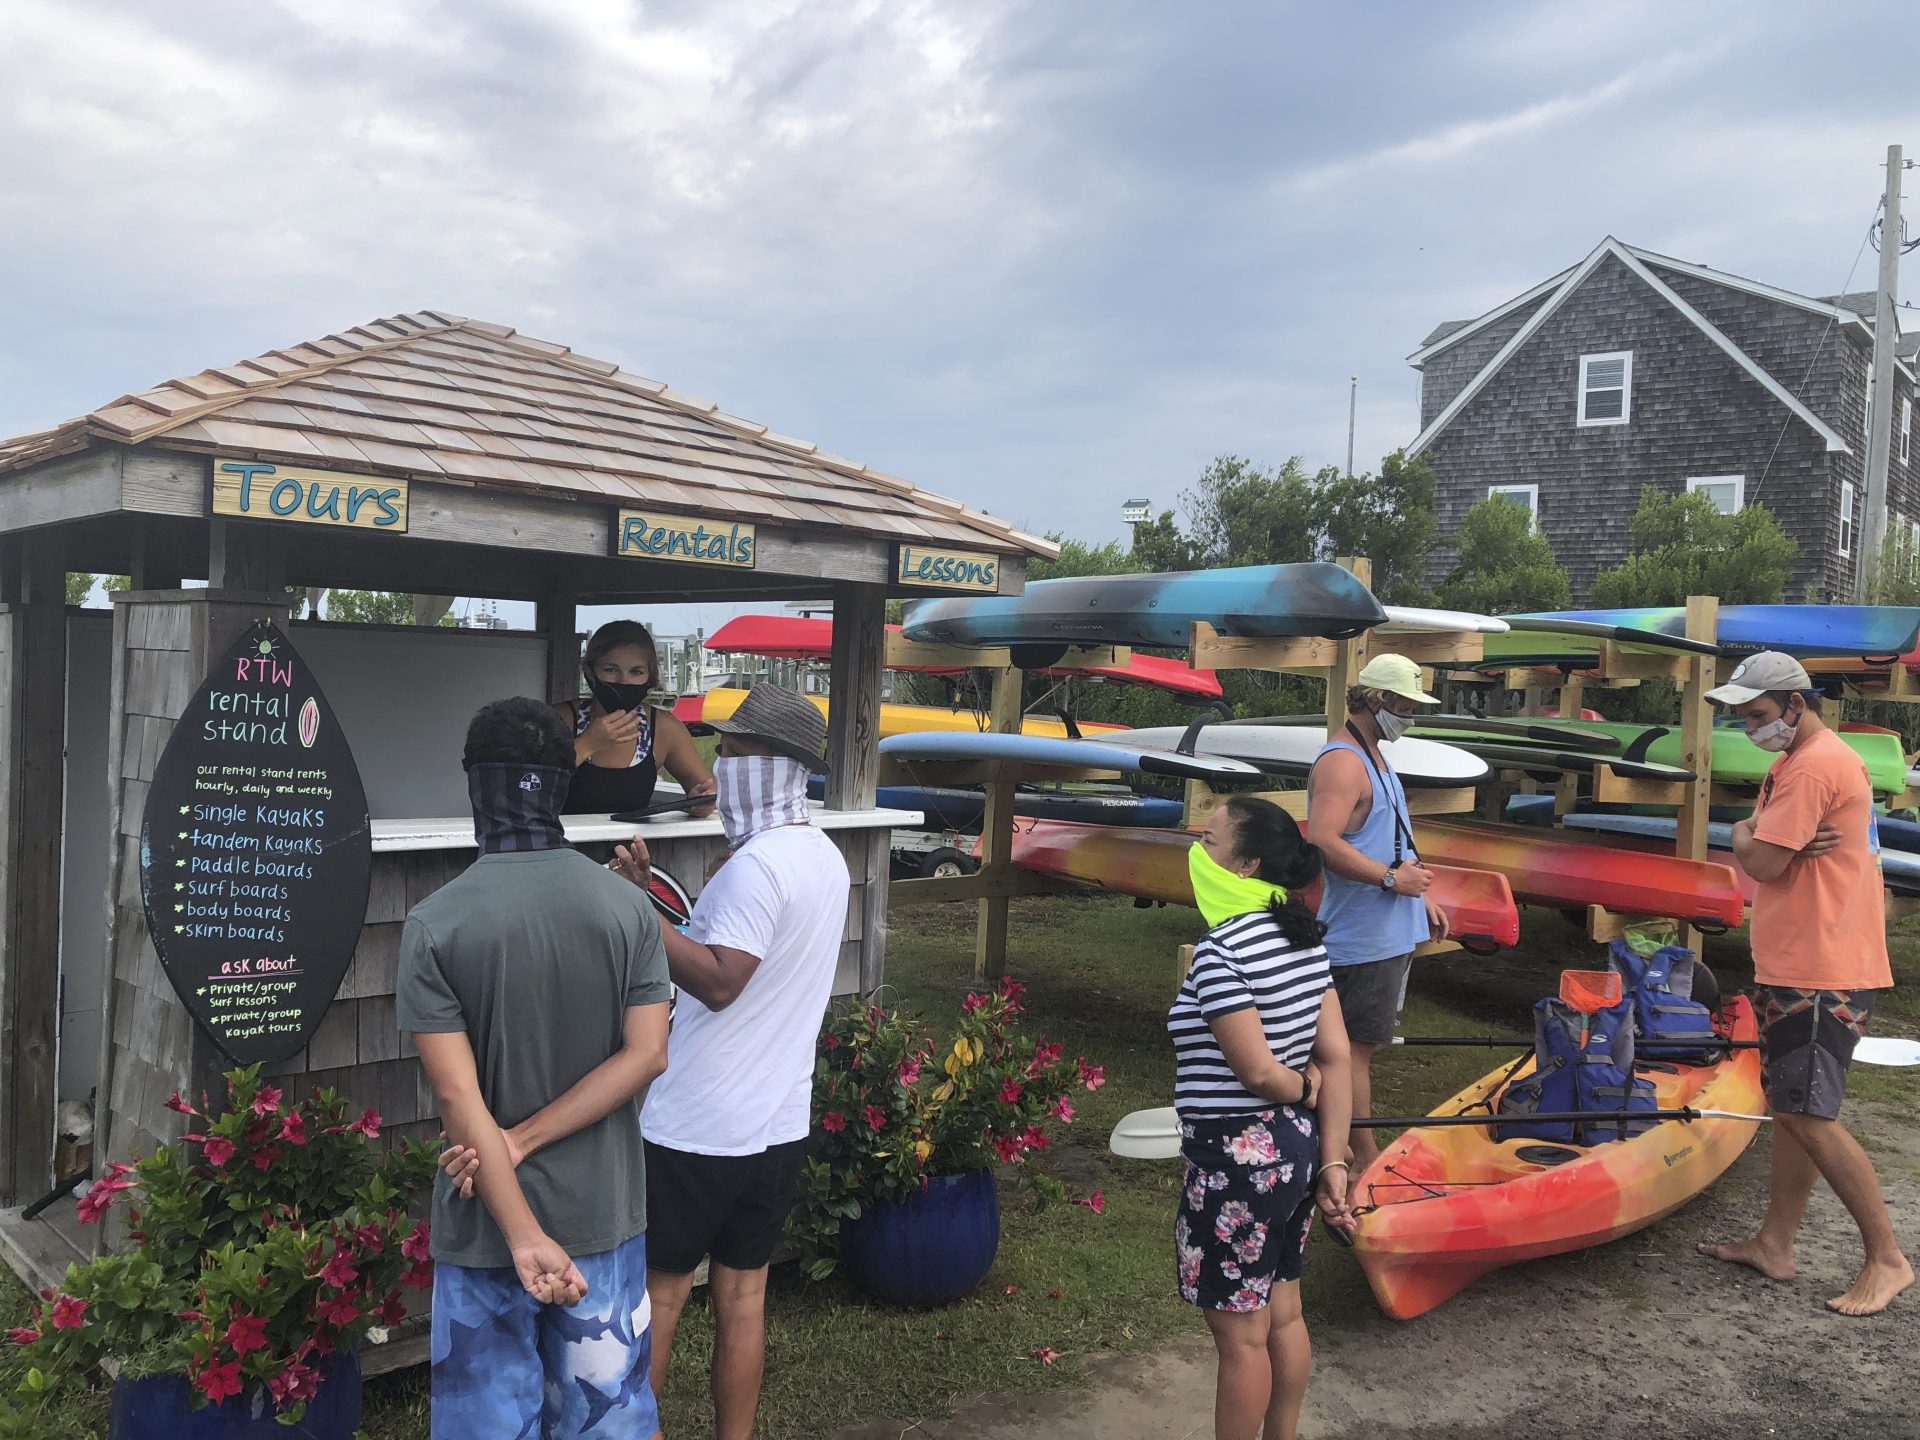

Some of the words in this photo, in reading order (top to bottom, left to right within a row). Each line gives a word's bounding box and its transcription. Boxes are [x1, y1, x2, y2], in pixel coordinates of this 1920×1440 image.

[221, 463, 401, 525] Tours
[622, 517, 752, 562] Rentals
[903, 548, 994, 585] Lessons
[237, 656, 291, 687] RTW
[210, 691, 288, 717] rental
[204, 720, 287, 744] stand
[197, 766, 218, 774] our
[223, 766, 255, 777] rental
[262, 768, 293, 779] stand
[298, 769, 326, 779] rents
[196, 779, 238, 795] hourly,
[242, 784, 270, 798] daily
[276, 785, 294, 793] and
[298, 787, 332, 800] weekly
[189, 829, 259, 851] tandem
[192, 856, 250, 874] Paddle
[255, 857, 312, 879] boards
[230, 881, 287, 899] boards
[188, 900, 228, 919] body
[234, 902, 290, 921] boards
[228, 923, 283, 942] boards
[256, 954, 297, 973] about
[236, 994, 276, 1006] lessons
[268, 1024, 301, 1033] tours
